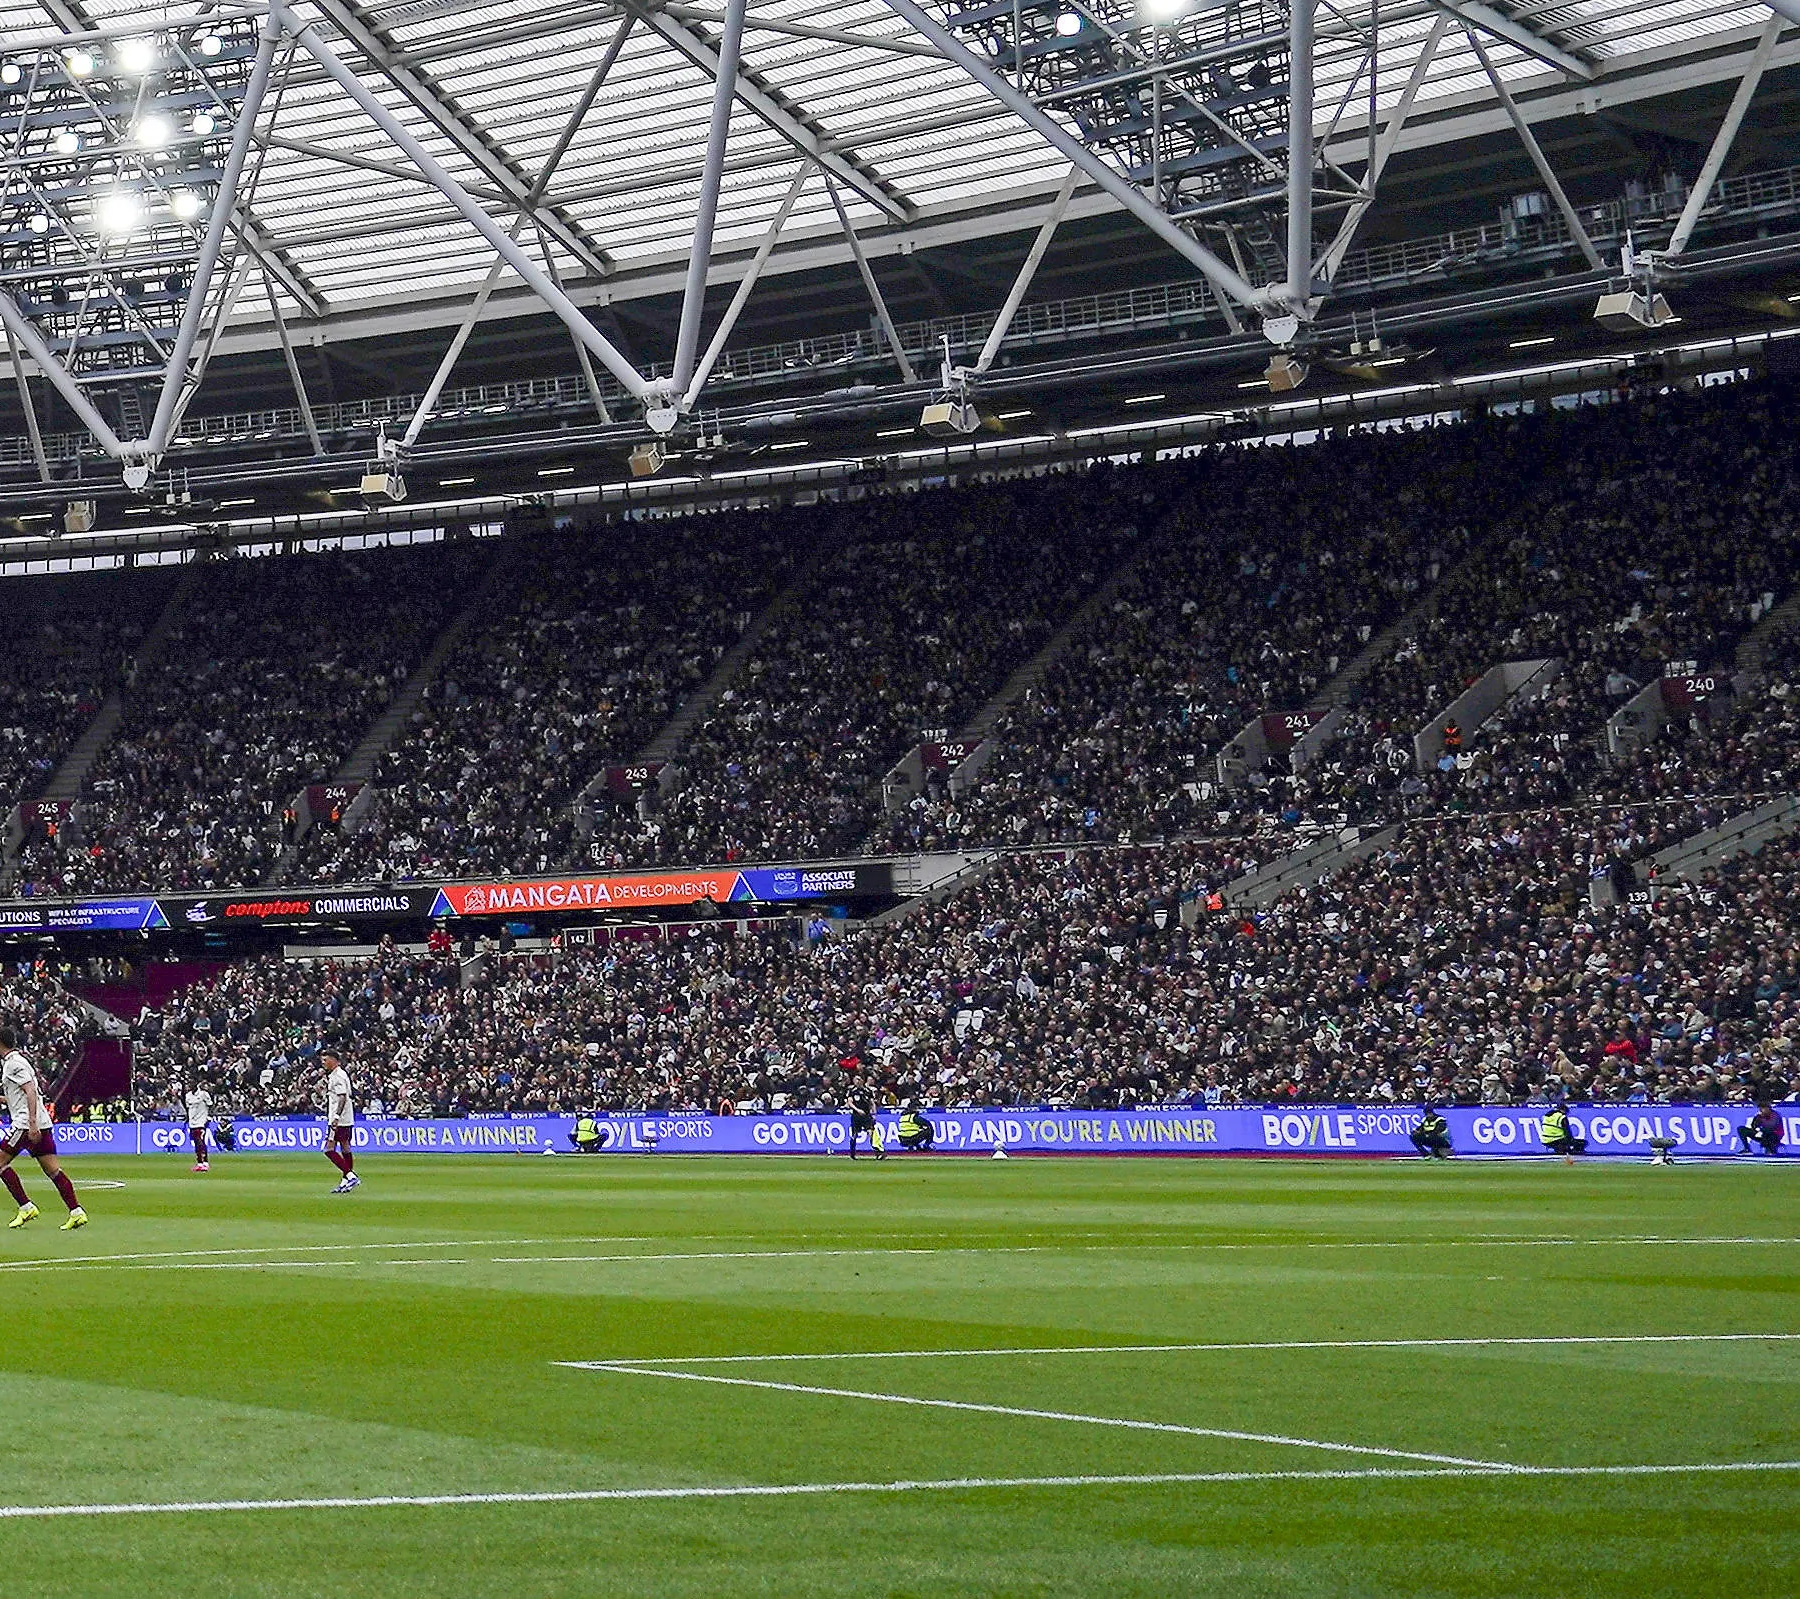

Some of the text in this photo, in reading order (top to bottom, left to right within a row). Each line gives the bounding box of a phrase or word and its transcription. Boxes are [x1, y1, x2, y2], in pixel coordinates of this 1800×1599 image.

[1686, 677, 1715, 693] 240
[1284, 714, 1310, 728] 241
[940, 744, 964, 756] 242
[625, 767, 647, 779] 243
[325, 787, 346, 799] 244
[37, 802, 59, 814] 245
[802, 870, 856, 883] ASSOCIATE
[802, 880, 856, 892] PARTNERS
[488, 881, 719, 909] MANGATA DEVELOPMENTS
[1628, 891, 1648, 902] 139
[224, 896, 410, 919] comptons COMMERCIALS
[58, 1126, 113, 1142] SPORTS
[153, 1128, 186, 1147] GO
[237, 1127, 297, 1147] GOALS
[372, 1127, 436, 1146] YOU'RE
[441, 1128, 452, 1146] A
[457, 1126, 537, 1146] WINNER
[598, 1120, 713, 1148] OYLE SPORTS
[753, 1121, 789, 1145] GO
[790, 1121, 846, 1145] TWO
[932, 1121, 965, 1147] UP,
[970, 1119, 1023, 1143] AND
[1024, 1119, 1102, 1143] YOU'RE
[1108, 1120, 1123, 1142] A
[1125, 1118, 1218, 1143] WINNER
[1262, 1113, 1422, 1147] BOYLE SPORTS
[1472, 1116, 1517, 1145] GO
[1590, 1116, 1686, 1146] GOALS
[1690, 1116, 1738, 1151] UP,
